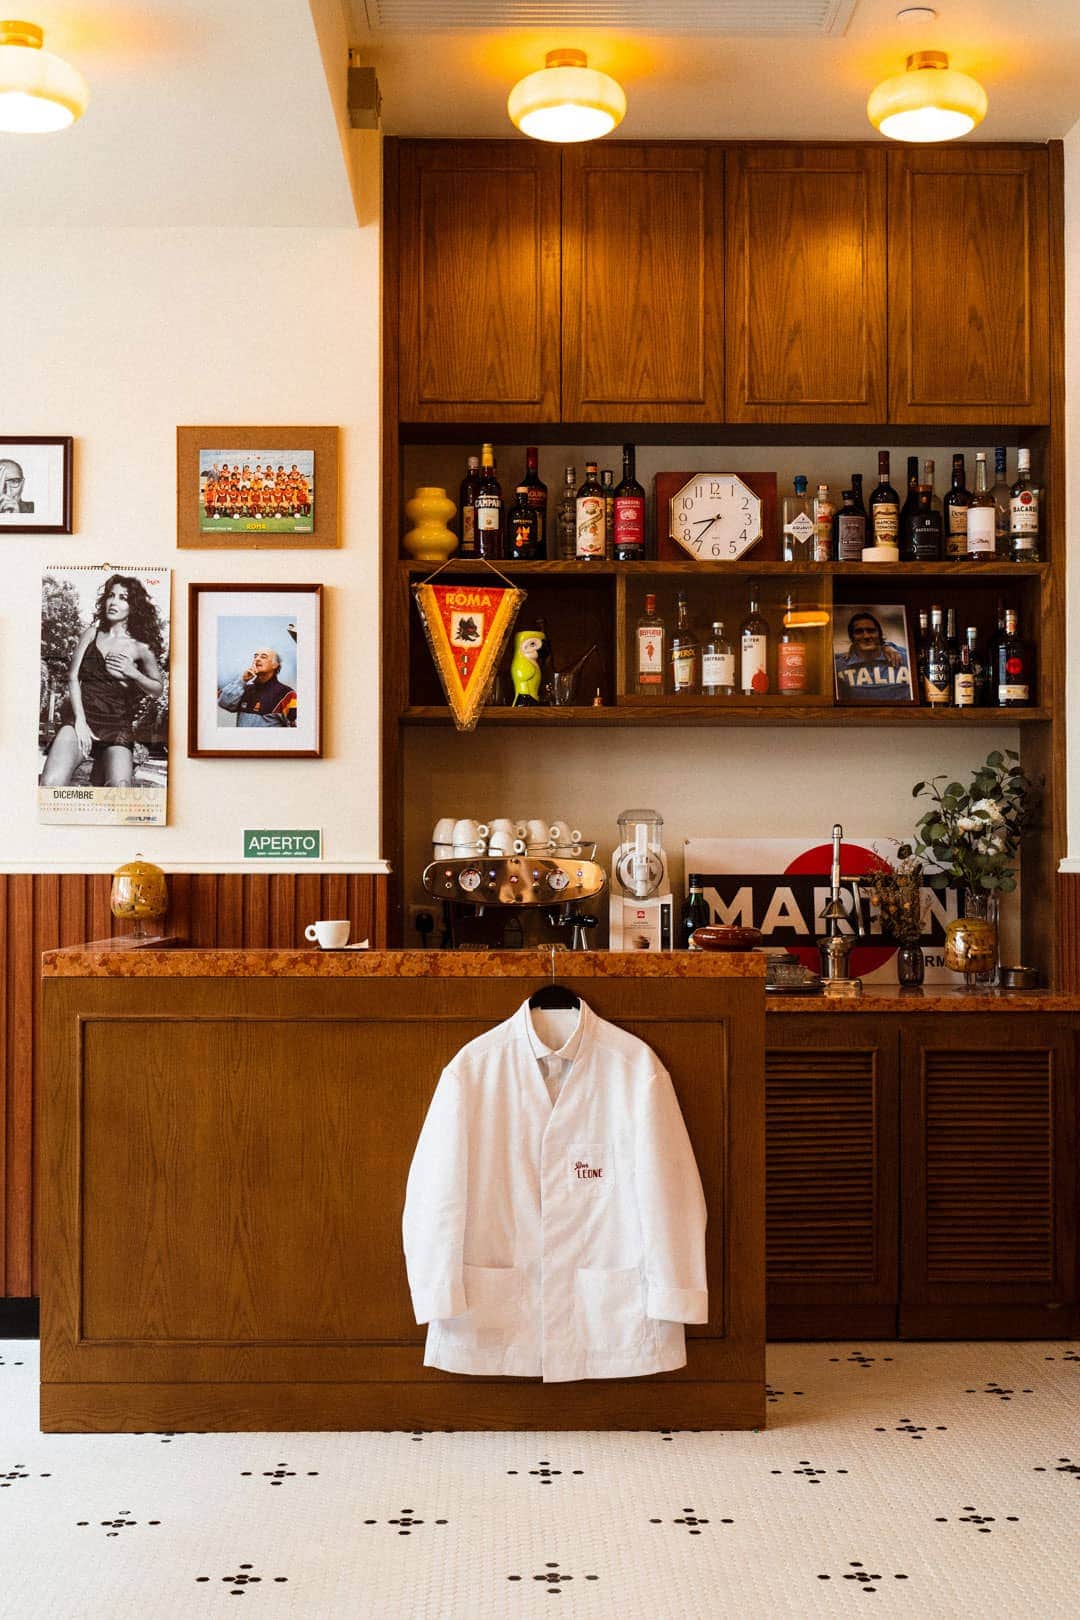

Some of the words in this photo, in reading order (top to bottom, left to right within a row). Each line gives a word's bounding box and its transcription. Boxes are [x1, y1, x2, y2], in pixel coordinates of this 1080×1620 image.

[695, 486, 703, 498] 11
[710, 482, 720, 495] 12
[682, 497, 694, 510] 10
[741, 497, 750, 510] 2
[678, 513, 688, 526] 9
[744, 513, 753, 526] 3
[683, 528, 693, 541] 8
[739, 529, 748, 541] 4
[694, 540, 704, 553] 7
[711, 544, 721, 557] 6
[728, 541, 737, 554] 5
[445, 592, 493, 608] ROMA
[53, 790, 94, 800] DICEMBRE
[248, 836, 316, 850] APERTO
[577, 1168, 603, 1179] LEONE
